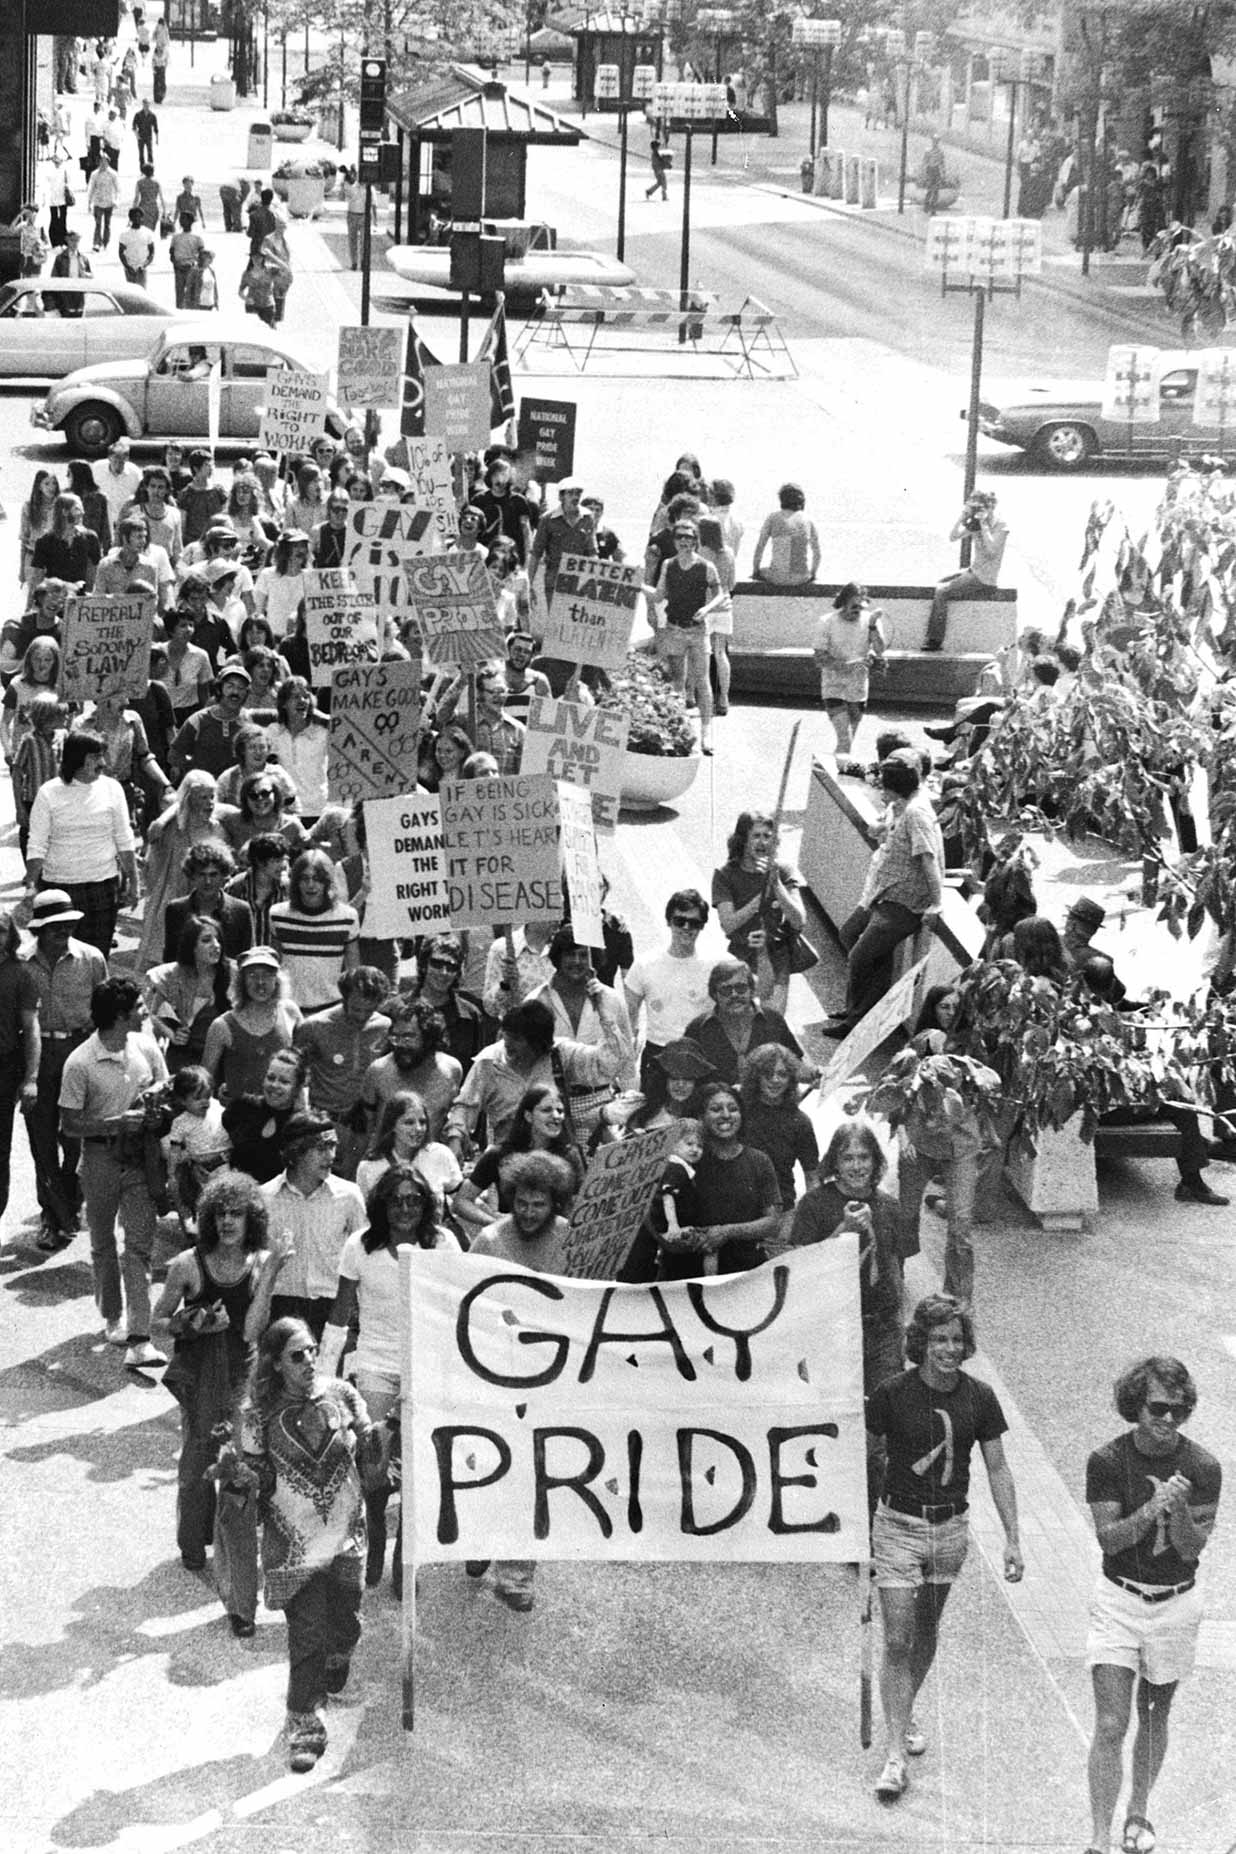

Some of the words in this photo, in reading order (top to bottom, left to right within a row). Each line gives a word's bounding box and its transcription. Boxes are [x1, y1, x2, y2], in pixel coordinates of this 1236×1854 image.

[271, 385, 322, 401] DEMAND
[280, 421, 300, 433] TO
[530, 410, 568, 425] NATIONAL
[538, 427, 557, 440] GAY
[535, 440, 560, 454] PRIDE
[353, 507, 434, 542] GAY
[413, 562, 481, 598] GAY
[566, 557, 636, 583] BETTER
[307, 595, 336, 610] THE
[323, 611, 346, 627] OUT
[346, 611, 362, 625] OF
[568, 603, 606, 626] than
[96, 625, 125, 639] THE
[330, 626, 354, 641] OUR
[86, 654, 129, 675] LAW
[335, 667, 387, 689] GAYS
[333, 690, 384, 710] MAKE
[529, 697, 623, 748] LIVE
[547, 739, 601, 764] AND
[547, 759, 600, 785] LET
[447, 785, 466, 802] IF
[475, 780, 530, 800] BEING
[400, 810, 439, 830] GAYS
[444, 805, 485, 824] GAY
[493, 803, 507, 822] IS
[513, 801, 555, 821] SICK
[394, 834, 445, 854] DEMAN
[445, 827, 503, 849] LET'S
[510, 826, 559, 846] HEAR
[412, 856, 438, 873] THE
[450, 857, 469, 877] IT
[476, 855, 515, 876] FOR
[396, 881, 438, 900] RIGHT
[450, 880, 562, 912] DISEASE
[408, 904, 450, 923] WORK
[583, 1169, 632, 1200] COME
[570, 1193, 625, 1229] COME
[621, 1177, 660, 1209] OUT
[456, 1265, 790, 1389] GAY
[431, 1422, 842, 1545] PRIDE
